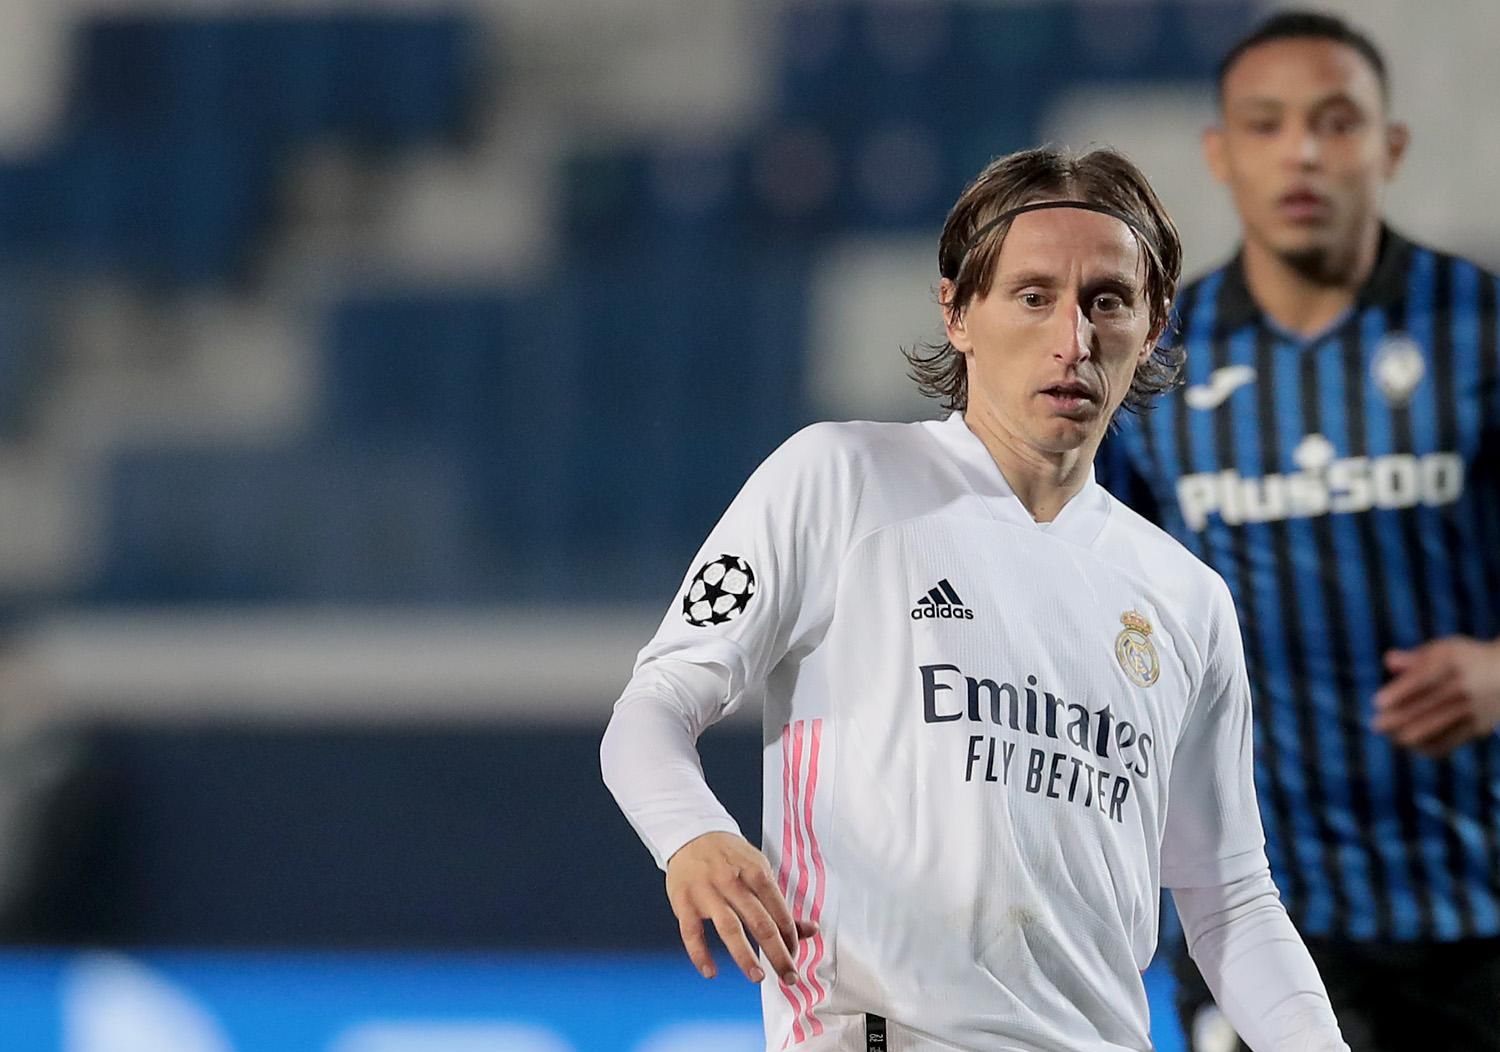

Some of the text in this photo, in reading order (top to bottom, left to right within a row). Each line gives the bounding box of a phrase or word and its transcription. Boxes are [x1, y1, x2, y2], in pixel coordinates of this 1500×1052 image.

[1176, 432, 1465, 532] Plus500
[911, 603, 974, 620] adidas
[919, 663, 1153, 779] Emirates
[965, 734, 1130, 824] FLY BETTER
